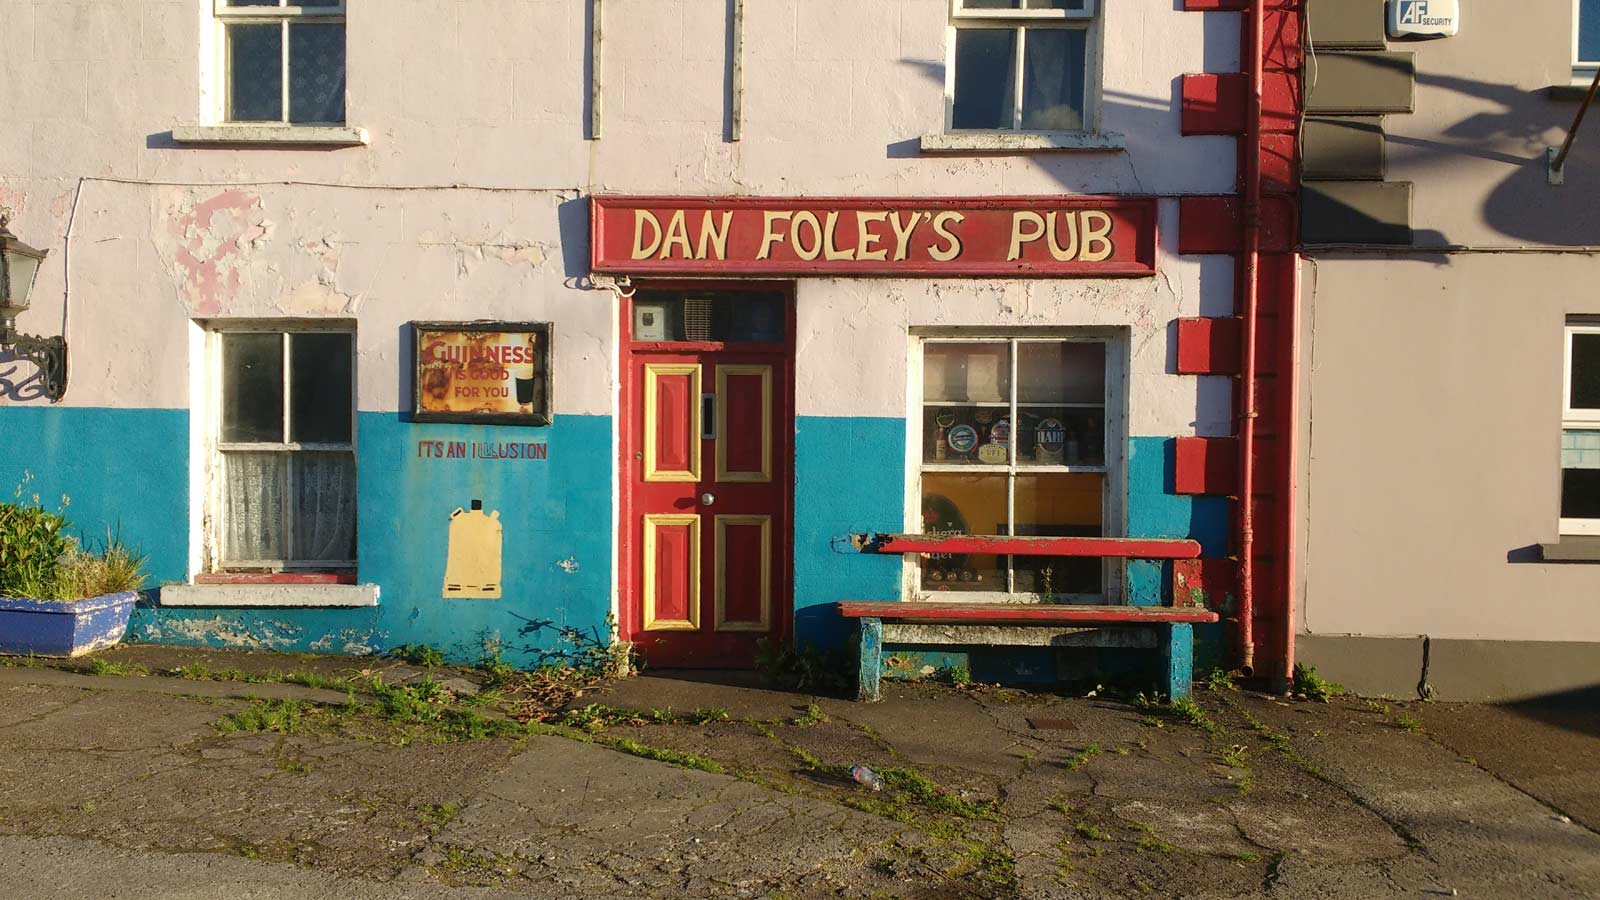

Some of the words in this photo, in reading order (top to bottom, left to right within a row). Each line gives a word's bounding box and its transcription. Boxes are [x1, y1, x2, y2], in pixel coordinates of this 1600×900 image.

[1401, 1, 1428, 24] AF
[1423, 17, 1452, 26] SECURITY
[631, 209, 733, 260] DAN
[756, 210, 965, 261] FOLEY'S
[1006, 210, 1113, 261] PUB
[430, 340, 534, 365] GUINNESS
[455, 369, 466, 381] IS
[470, 369, 509, 381] GOOD
[455, 387, 480, 398] FOR
[483, 387, 509, 398] YOU
[446, 441, 465, 458] AN
